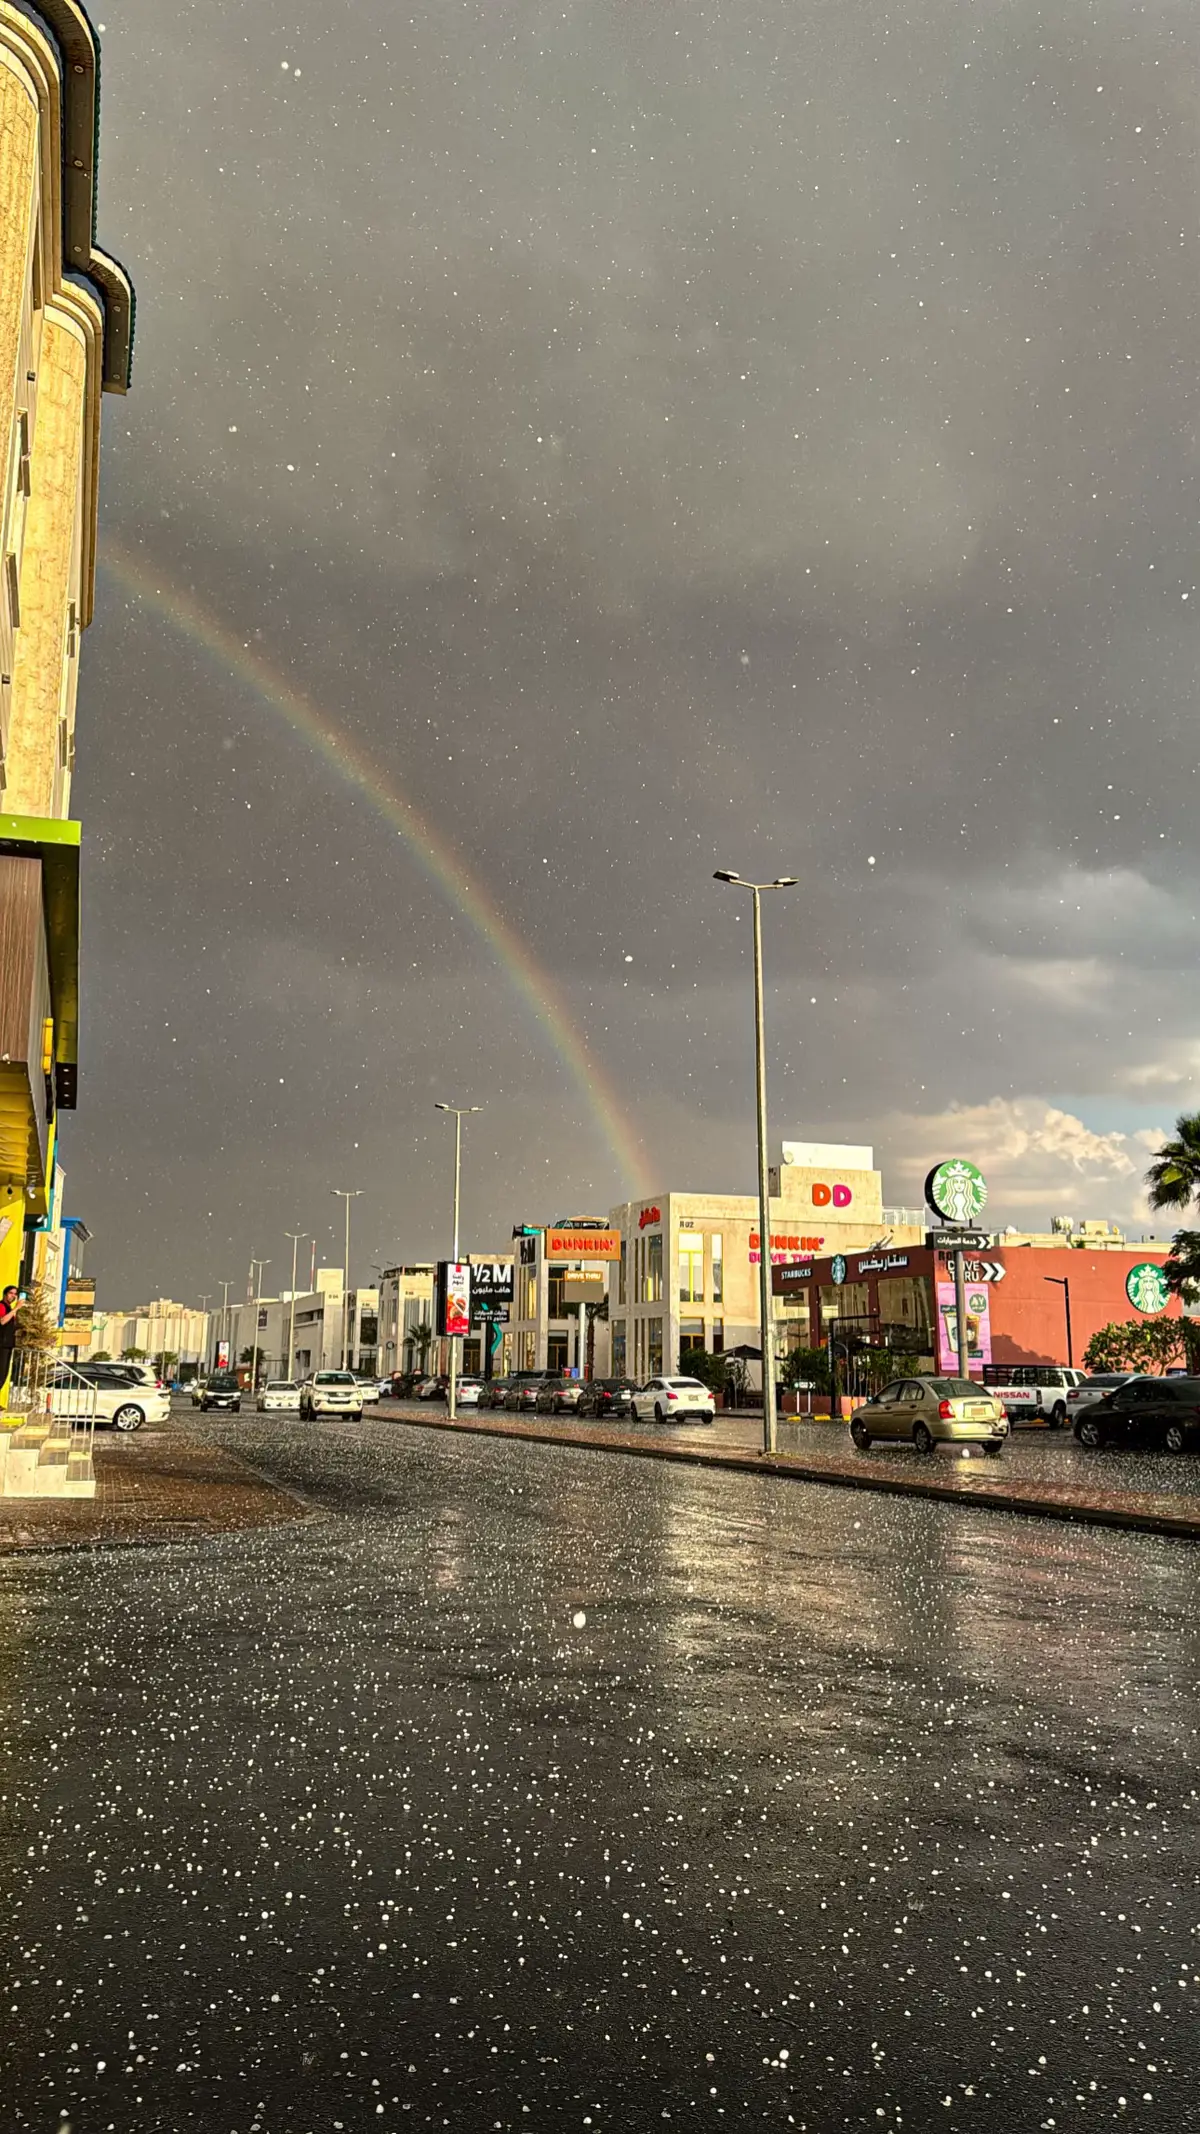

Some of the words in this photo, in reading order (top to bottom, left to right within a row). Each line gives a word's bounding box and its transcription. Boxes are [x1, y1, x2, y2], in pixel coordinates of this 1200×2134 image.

[812, 1183, 852, 1208] DD
[937, 1236, 961, 1246] السيارات
[567, 1272, 584, 1280] DRIVE
[585, 1272, 601, 1280] THRU
[781, 1268, 812, 1280] STARBUCKS
[472, 1285, 493, 1295] مليون
[494, 1286, 511, 1294] هاف
[993, 1391, 1030, 1399] NISSAN
